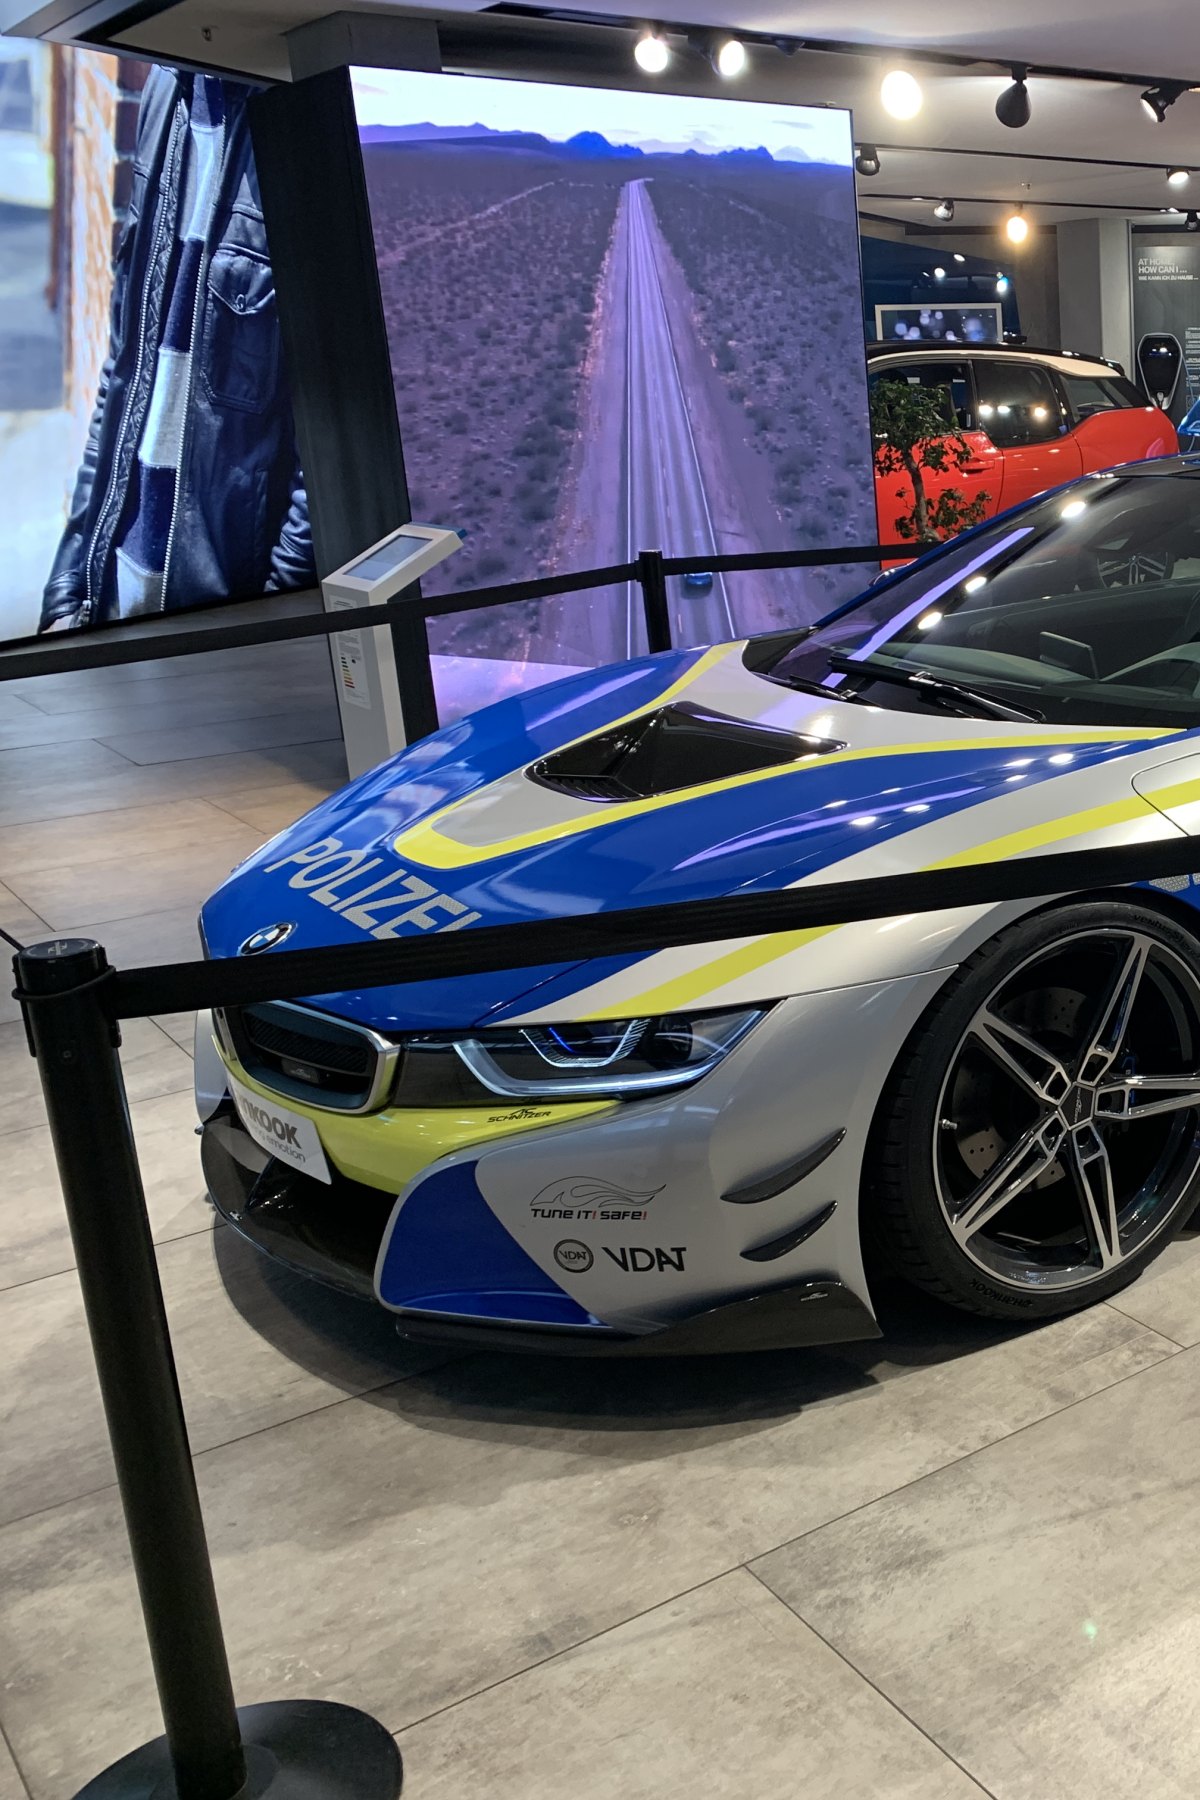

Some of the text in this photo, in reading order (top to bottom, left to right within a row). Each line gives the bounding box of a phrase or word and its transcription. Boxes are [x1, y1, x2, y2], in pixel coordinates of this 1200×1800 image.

[1138, 266, 1157, 274] HOW
[1175, 265, 1179, 273] I
[263, 836, 482, 940] POLIZEI
[487, 1111, 552, 1123] SCHNITZER
[577, 1209, 597, 1220] IT!
[601, 1247, 687, 1272] VDAT
